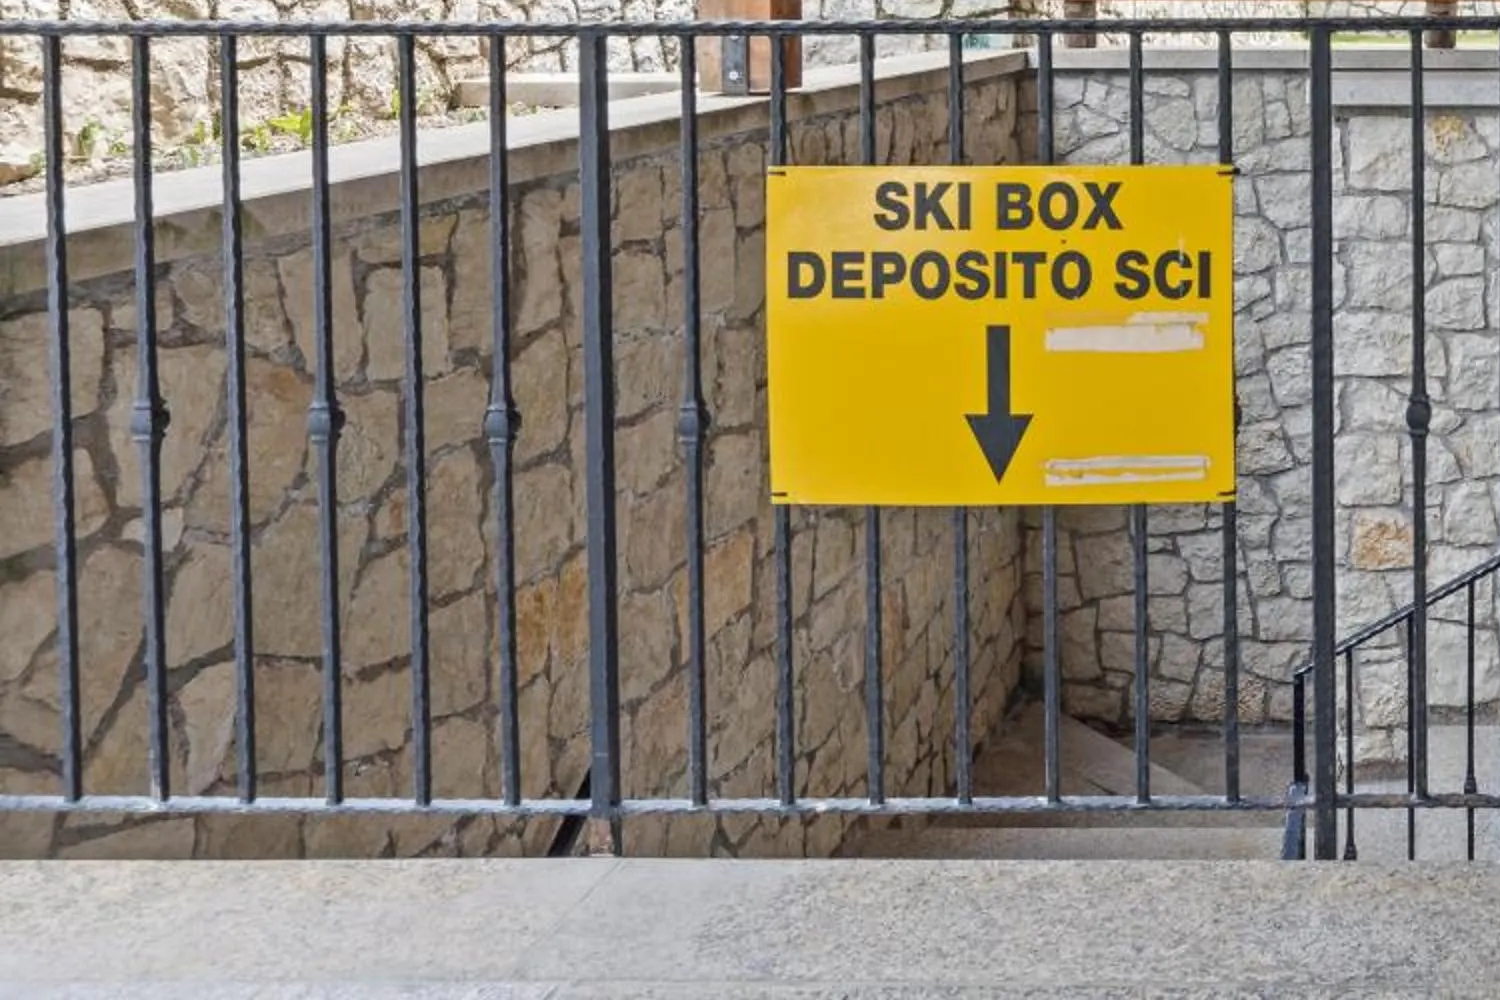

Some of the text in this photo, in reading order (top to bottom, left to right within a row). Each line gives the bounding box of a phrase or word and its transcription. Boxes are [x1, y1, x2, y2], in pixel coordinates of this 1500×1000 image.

[873, 181, 1124, 231] SKI BOX
[787, 250, 1212, 300] DEPOSITO SCI
